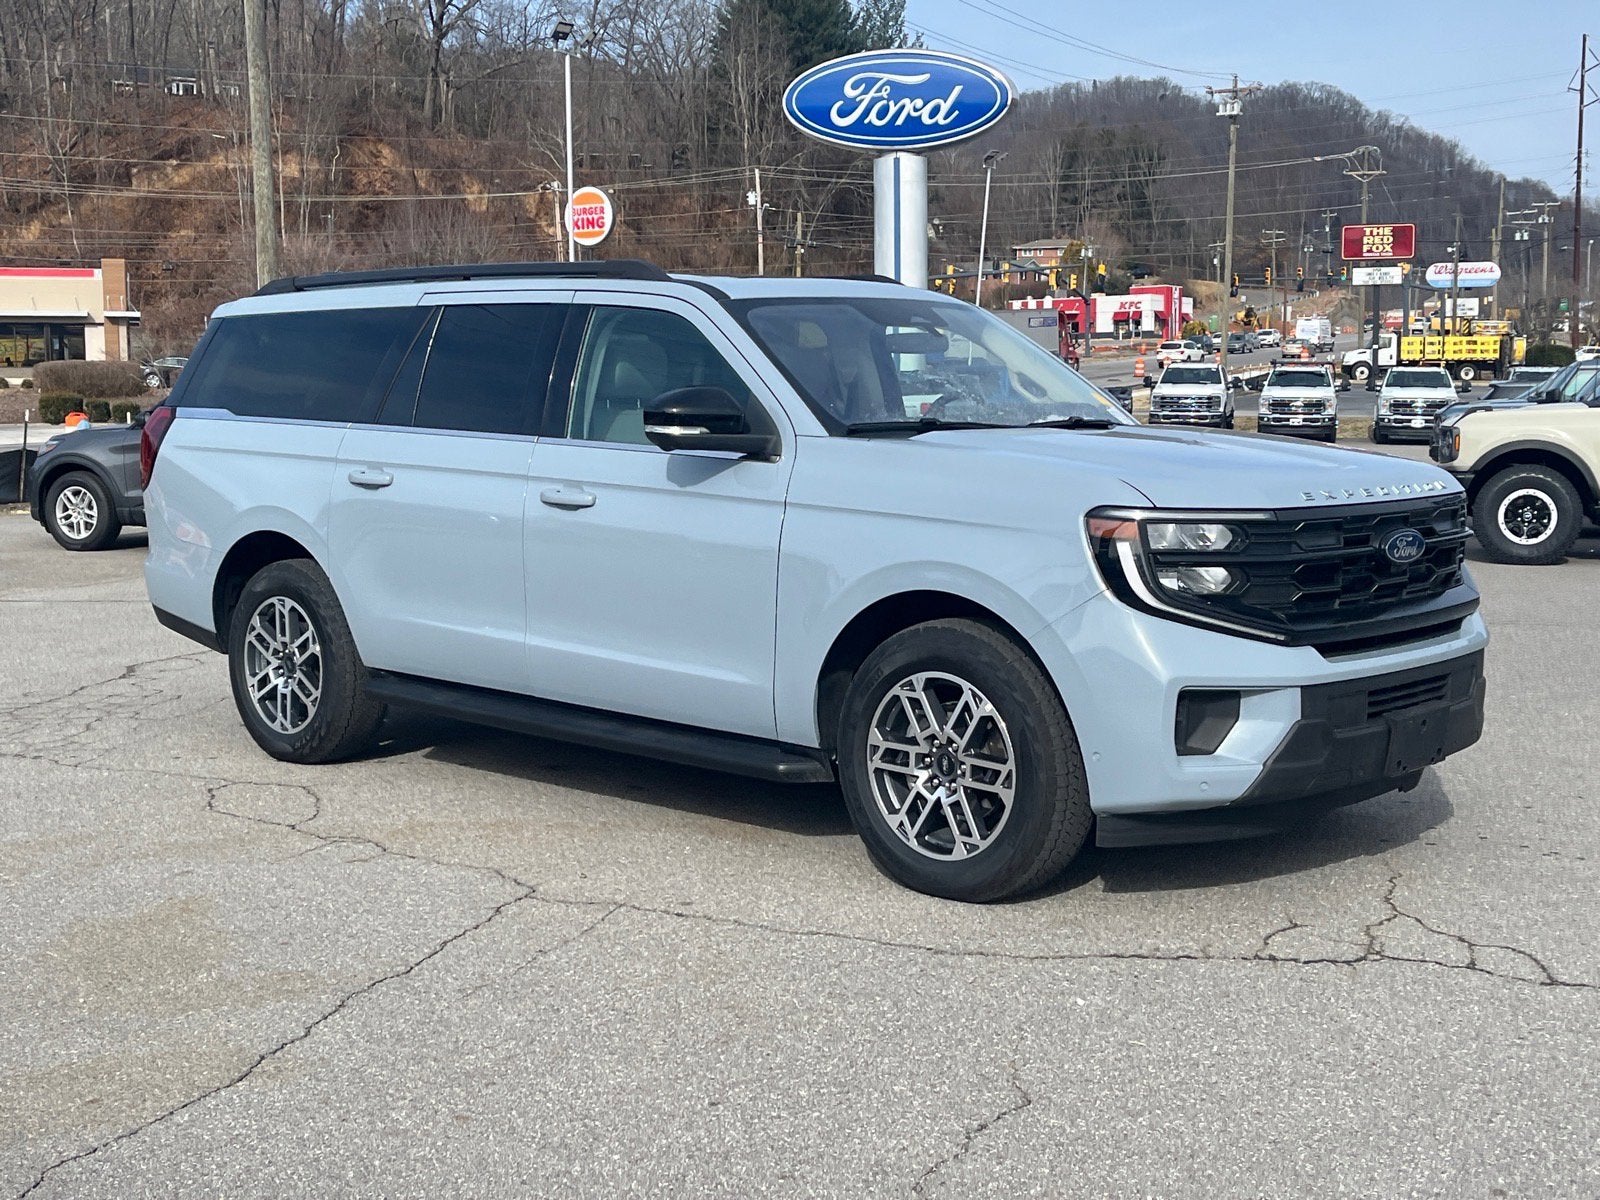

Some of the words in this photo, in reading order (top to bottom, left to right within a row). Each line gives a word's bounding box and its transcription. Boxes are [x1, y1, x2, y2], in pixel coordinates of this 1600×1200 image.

[830, 72, 963, 127] Ford
[572, 216, 606, 230] KING
[1363, 227, 1394, 235] THE
[1363, 236, 1394, 244] RED
[1363, 244, 1394, 252] FOX
[1433, 265, 1495, 276] Wagreens
[1119, 301, 1142, 310] KFC
[1300, 480, 1447, 501] EXPEDITION
[1394, 536, 1418, 558] Ford
